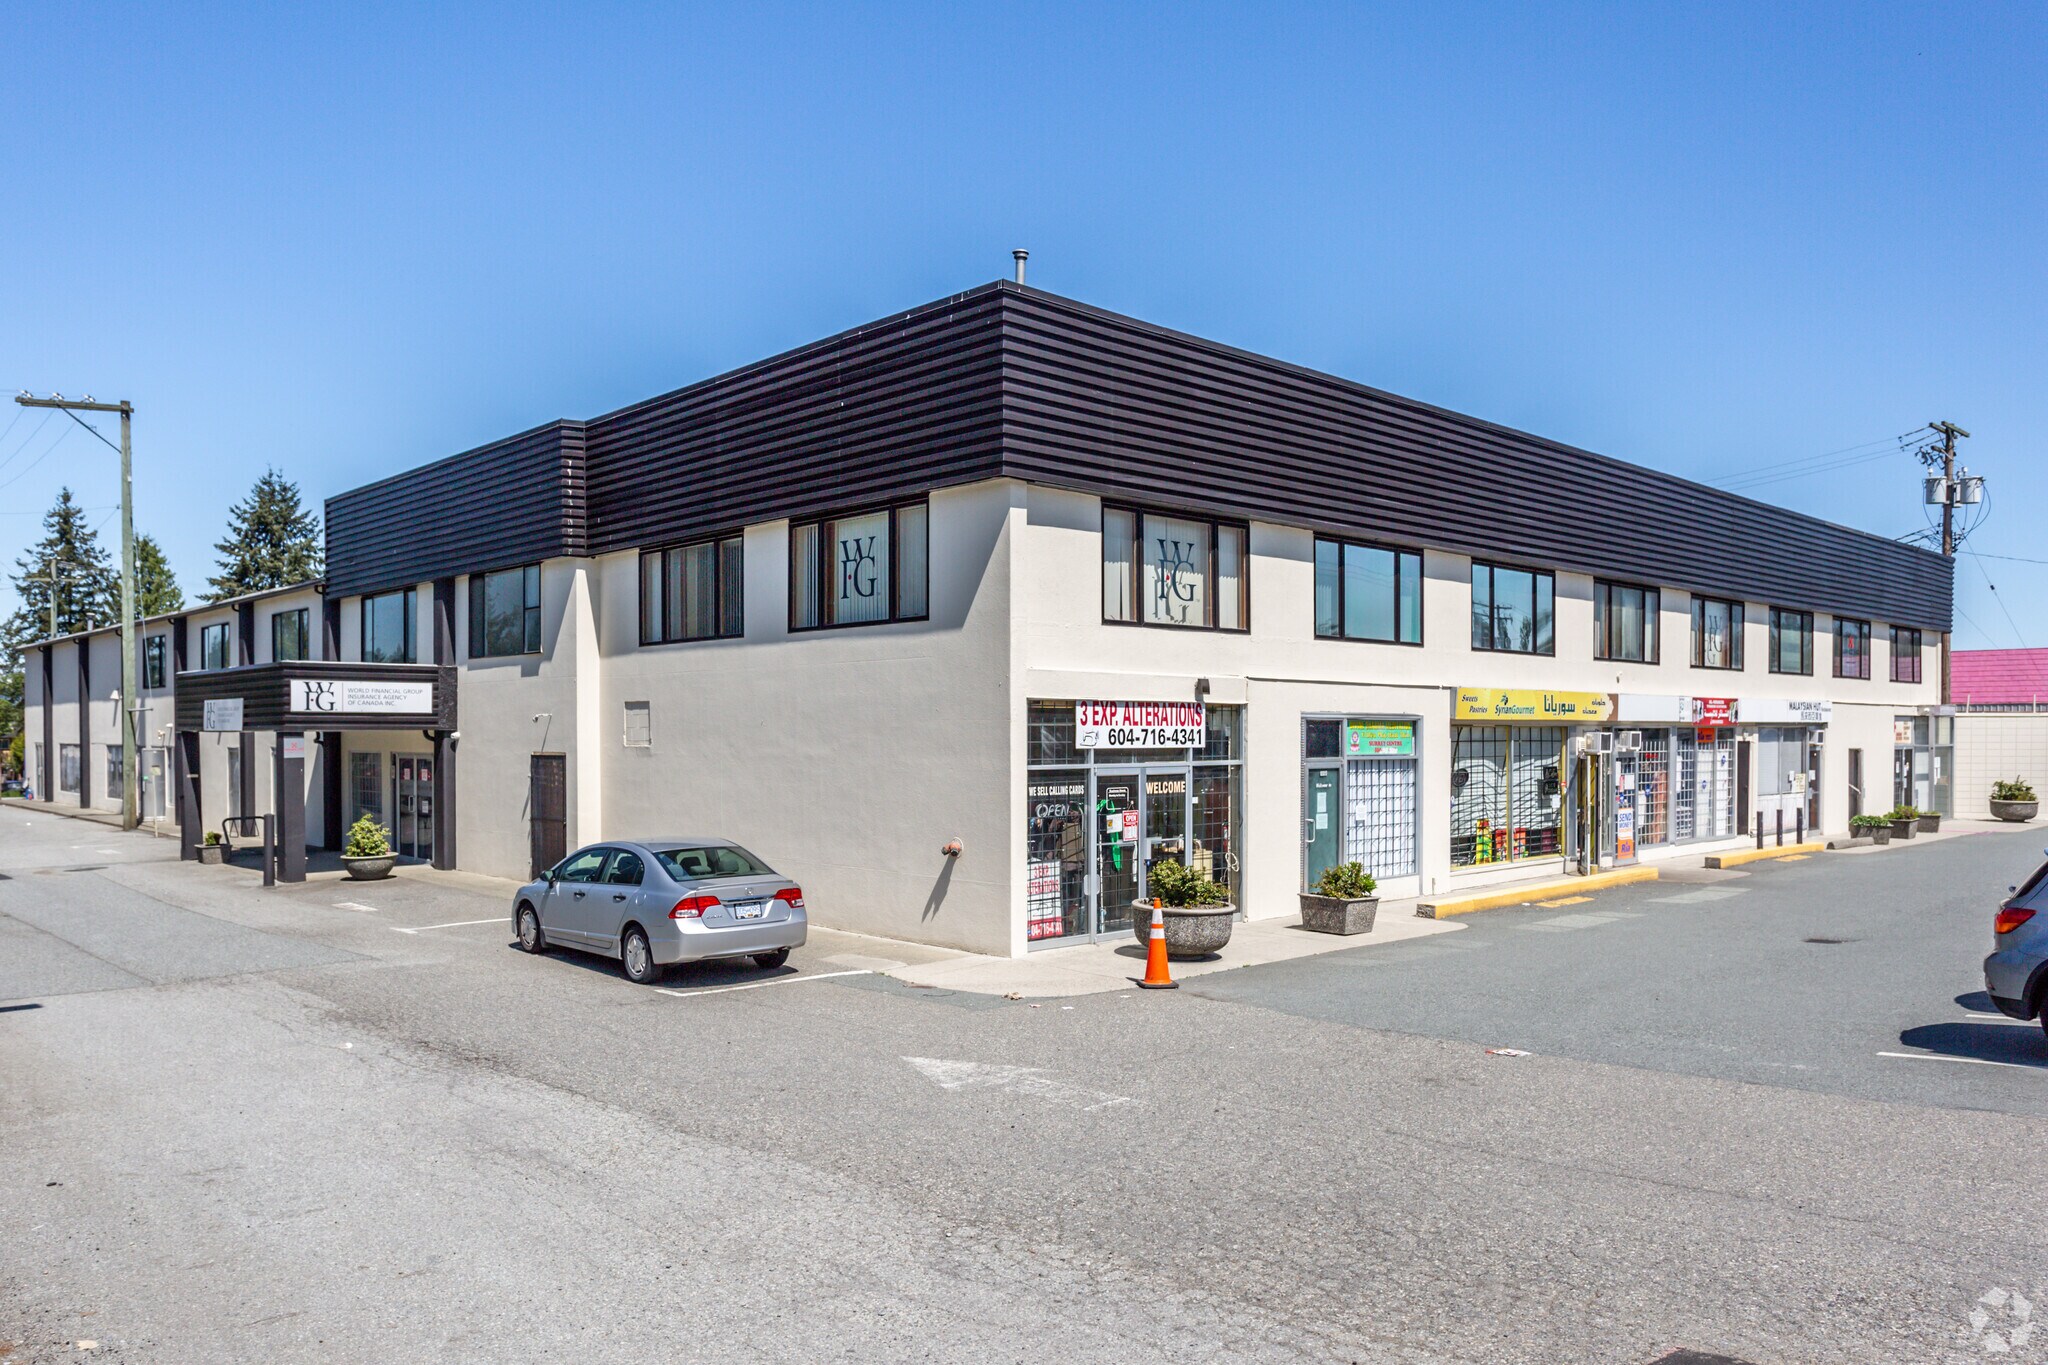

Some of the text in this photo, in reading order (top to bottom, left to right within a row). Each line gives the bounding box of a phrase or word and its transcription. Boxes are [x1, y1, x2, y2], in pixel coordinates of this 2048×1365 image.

[1789, 701, 1813, 710] MALAYSIAN
[1080, 700, 1203, 727] 3 EXP. ALTERATIONS
[1108, 728, 1202, 746] 604-716-4341
[1028, 784, 1085, 797] WE SELL CALLING CARDS
[1145, 781, 1186, 795] WELCOME
[1035, 803, 1070, 818] OPEN
[1619, 812, 1632, 822] SEND
